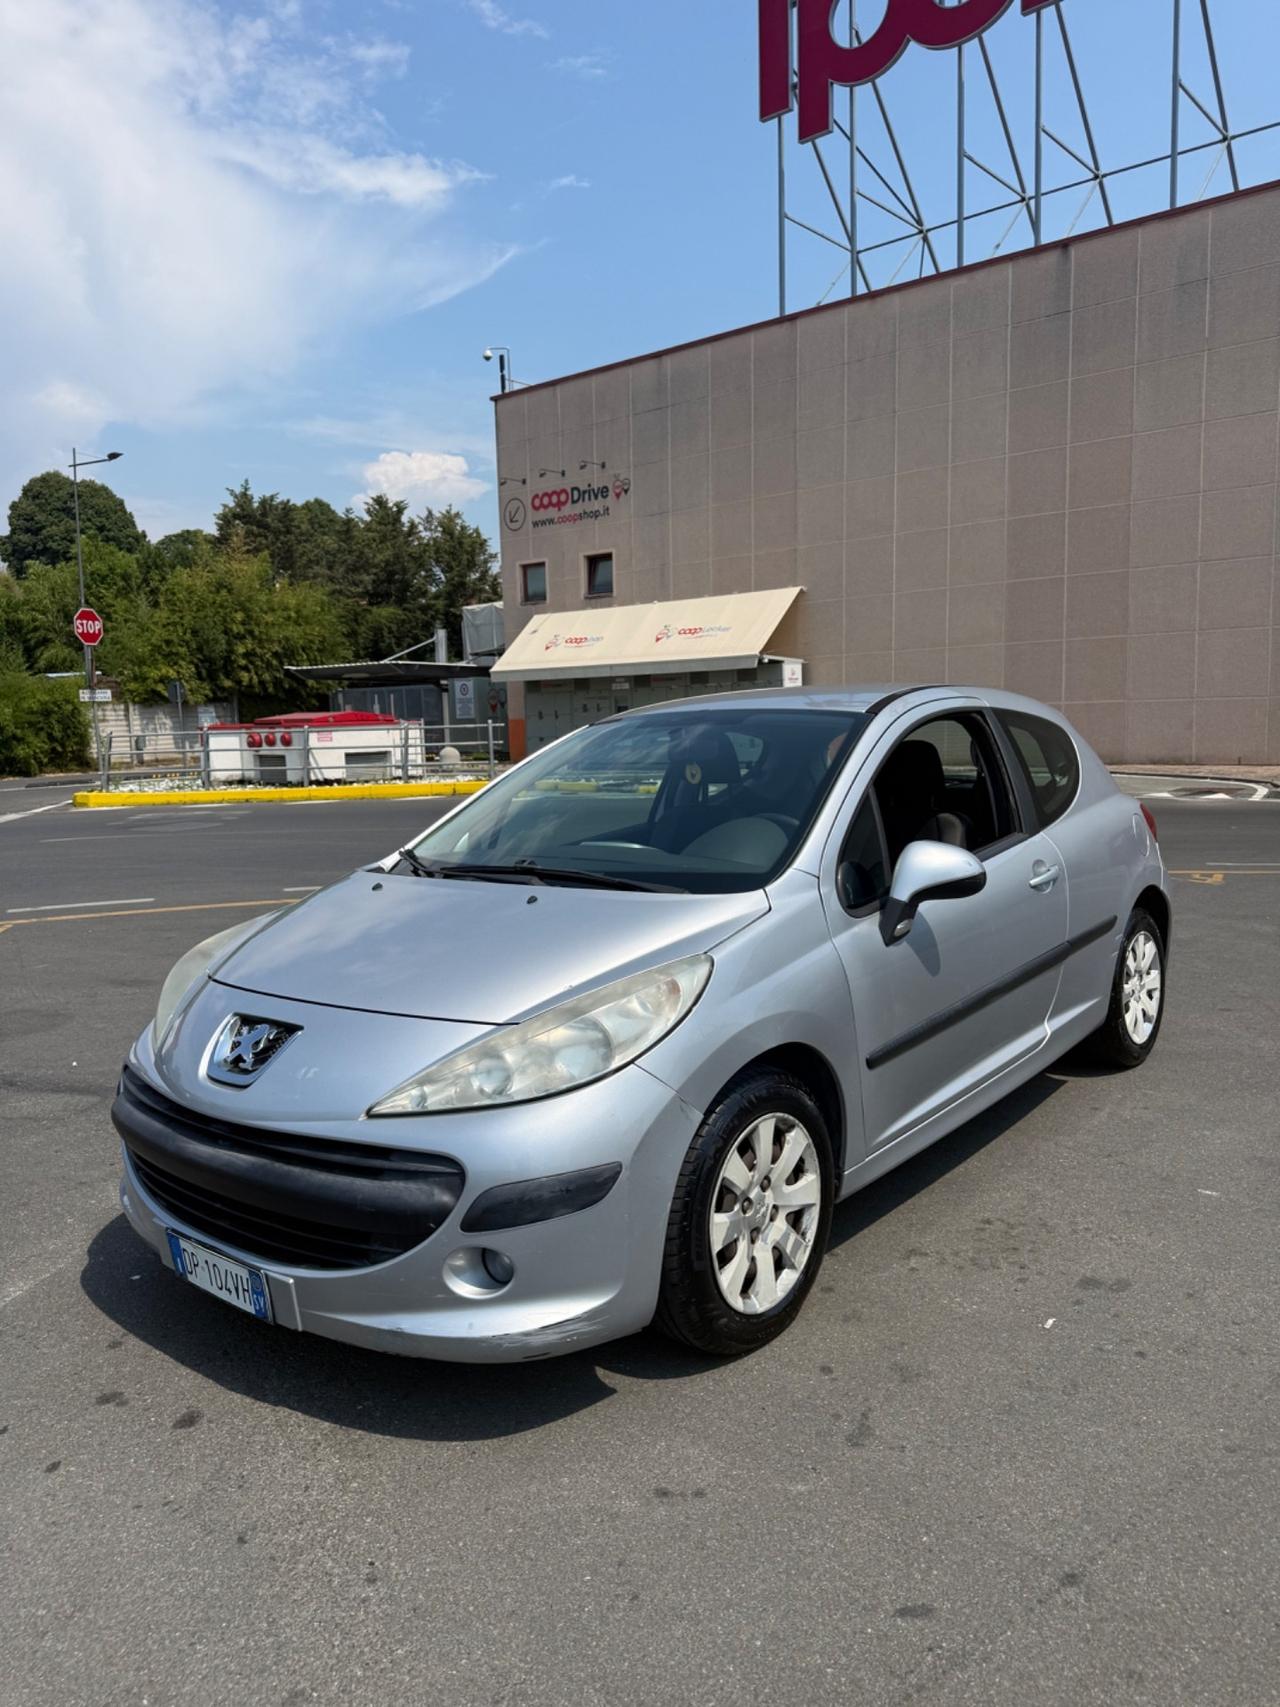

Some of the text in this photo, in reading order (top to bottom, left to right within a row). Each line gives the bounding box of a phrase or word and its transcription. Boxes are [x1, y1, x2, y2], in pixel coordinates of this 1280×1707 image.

[531, 505, 610, 528] www.coopshop.it
[76, 619, 101, 634] STOP
[183, 1247, 199, 1279] DP
[204, 1259, 252, 1306] 104VH
